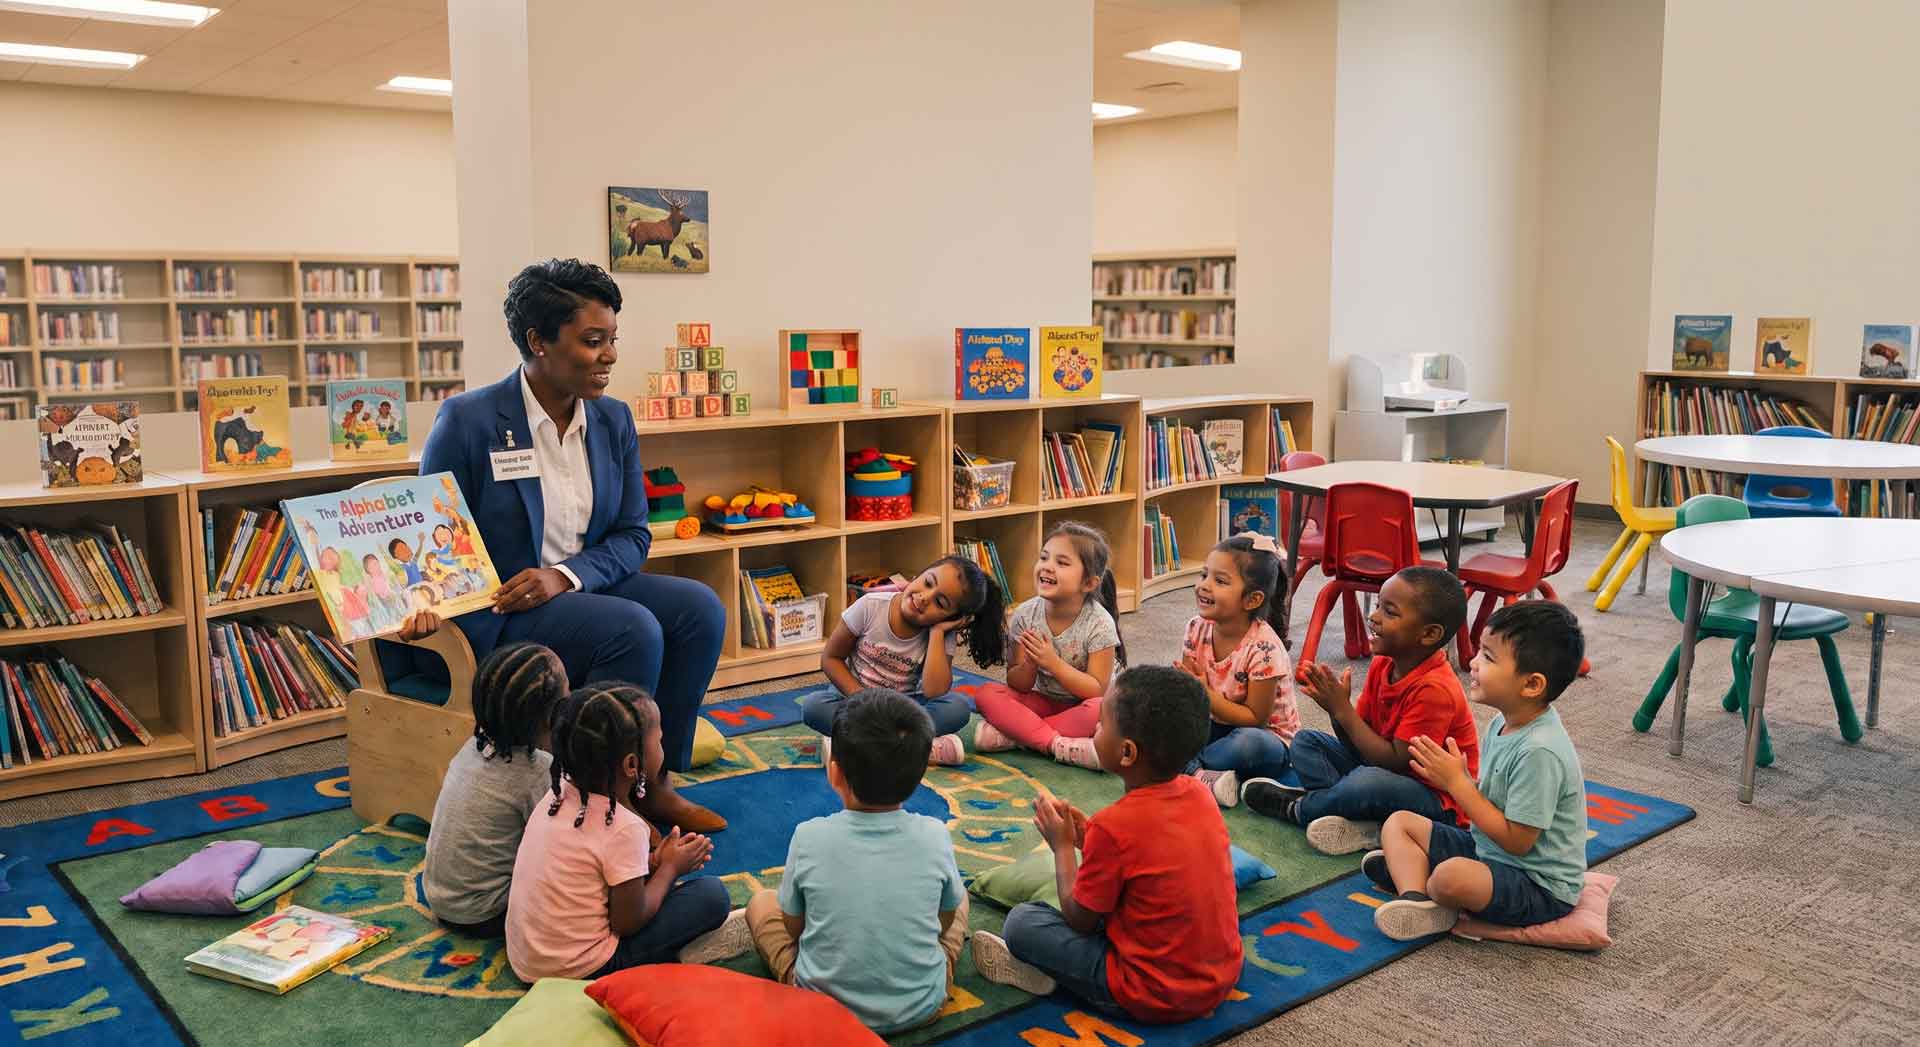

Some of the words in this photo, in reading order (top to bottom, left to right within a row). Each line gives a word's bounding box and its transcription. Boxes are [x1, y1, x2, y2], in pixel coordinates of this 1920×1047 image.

[694, 327, 708, 344] A
[680, 352, 694, 367] B
[707, 351, 721, 366] B
[665, 376, 677, 392] A
[722, 374, 735, 389] C
[316, 508, 339, 521] The
[340, 488, 416, 519] Alphabet
[338, 511, 425, 538] Adventure
[199, 795, 270, 823] B
[85, 818, 155, 847] A
